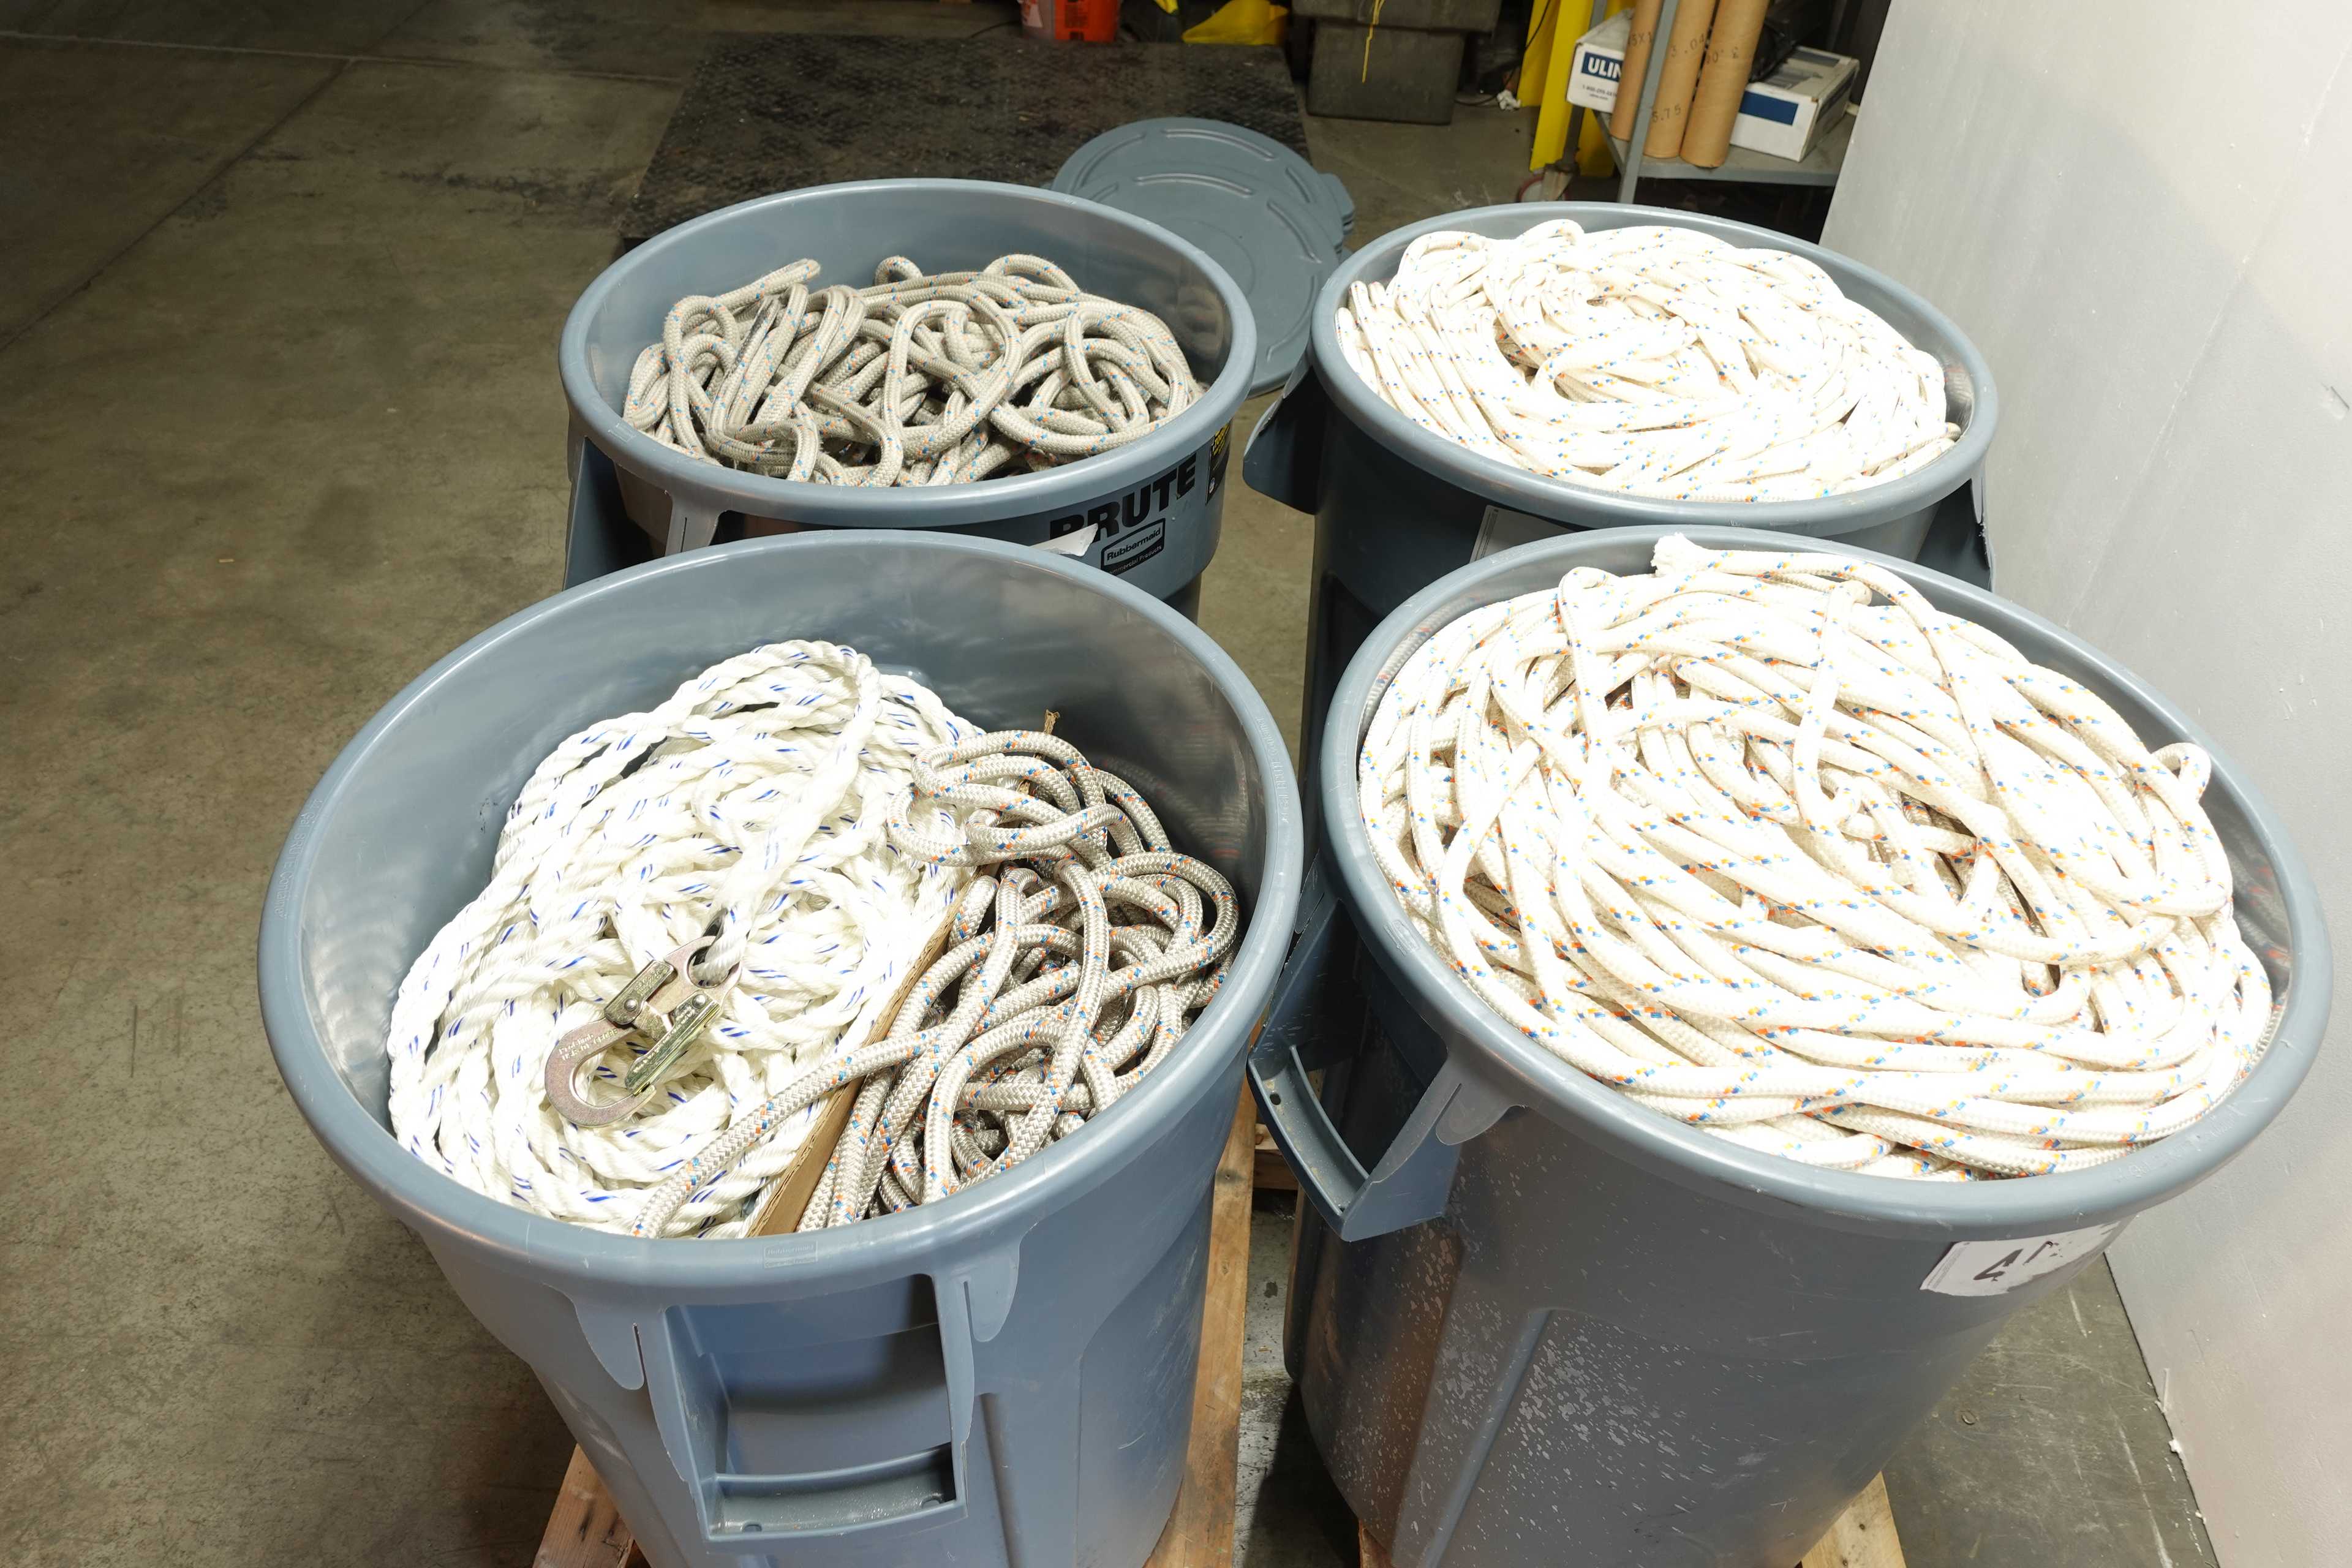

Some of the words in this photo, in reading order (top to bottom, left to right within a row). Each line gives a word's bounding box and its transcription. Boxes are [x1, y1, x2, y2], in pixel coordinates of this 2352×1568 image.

[1588, 56, 1621, 79] ULIN
[1107, 527, 1161, 560] Rubbermaid
[1139, 545, 1162, 561] Products
[284, 833, 306, 869] BRUTE
[274, 872, 294, 919] Container
